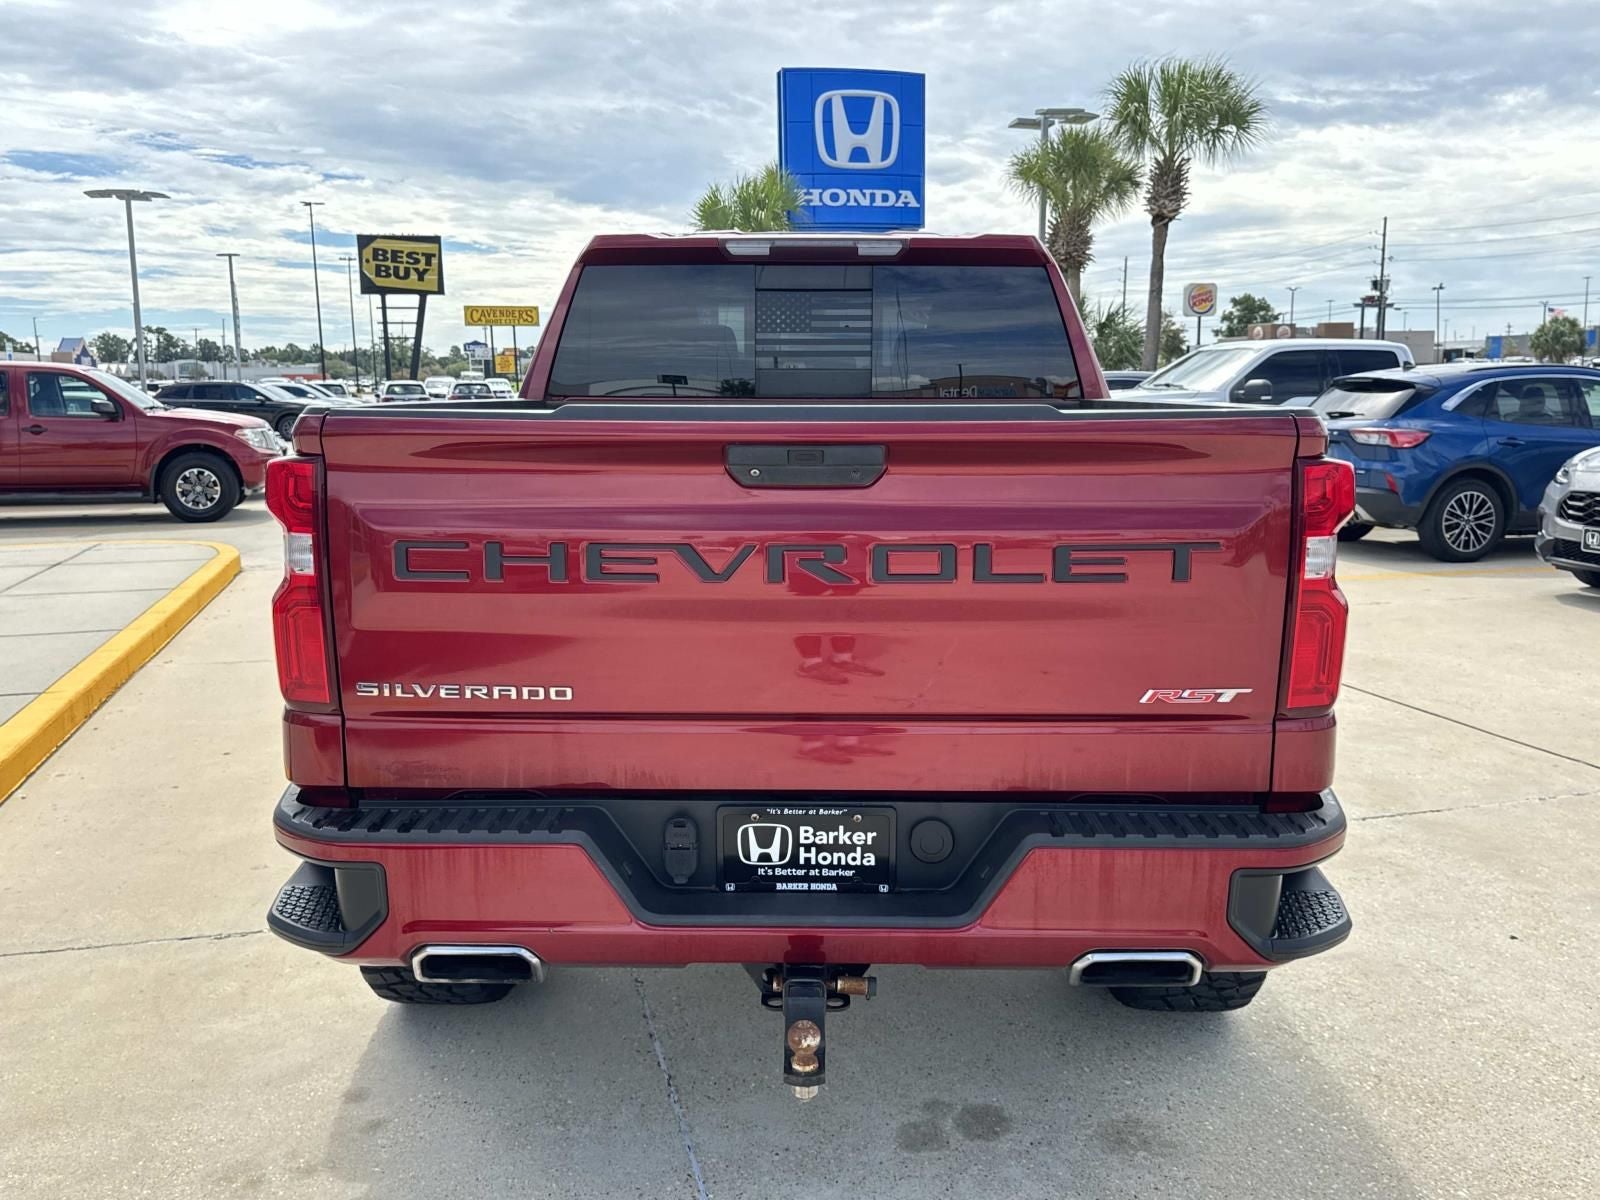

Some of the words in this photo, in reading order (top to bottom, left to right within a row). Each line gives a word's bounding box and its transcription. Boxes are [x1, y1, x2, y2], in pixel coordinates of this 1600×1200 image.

[799, 188, 920, 208] HONDA
[372, 247, 437, 267] BEST
[375, 263, 431, 282] BUY
[470, 308, 535, 324] CAVENDER'S
[393, 539, 1222, 585] CHEVROLET
[356, 682, 574, 702] SILVERADO
[1139, 688, 1254, 704] RST
[799, 825, 877, 845] Barker
[799, 847, 876, 866] Honda
[757, 867, 773, 876] It's
[775, 867, 807, 876] Better
[821, 867, 855, 877] Barker
[776, 882, 810, 891] BARKER
[810, 883, 838, 891] HONDA
